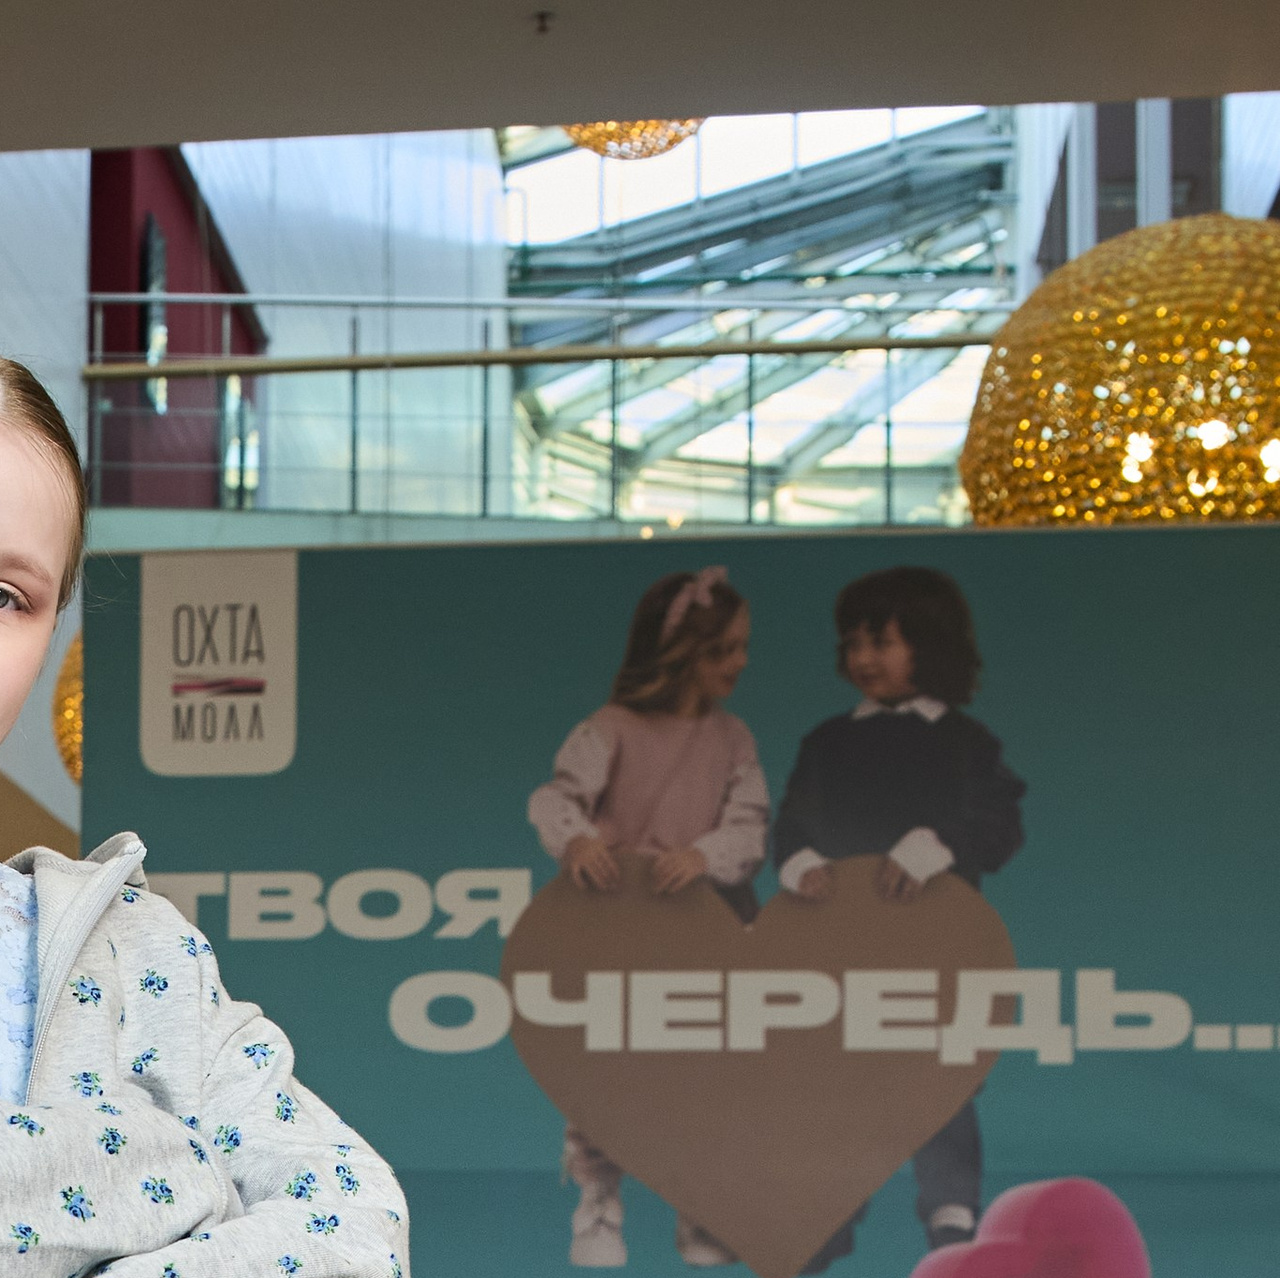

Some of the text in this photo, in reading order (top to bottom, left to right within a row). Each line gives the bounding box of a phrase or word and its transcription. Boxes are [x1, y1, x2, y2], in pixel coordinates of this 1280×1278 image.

[173, 602, 266, 668] ОХТА
[173, 701, 264, 744] МОЛЛ
[145, 867, 533, 941] ТВОЯ
[388, 968, 1280, 1066] ОЧЕРЕДЬ..
